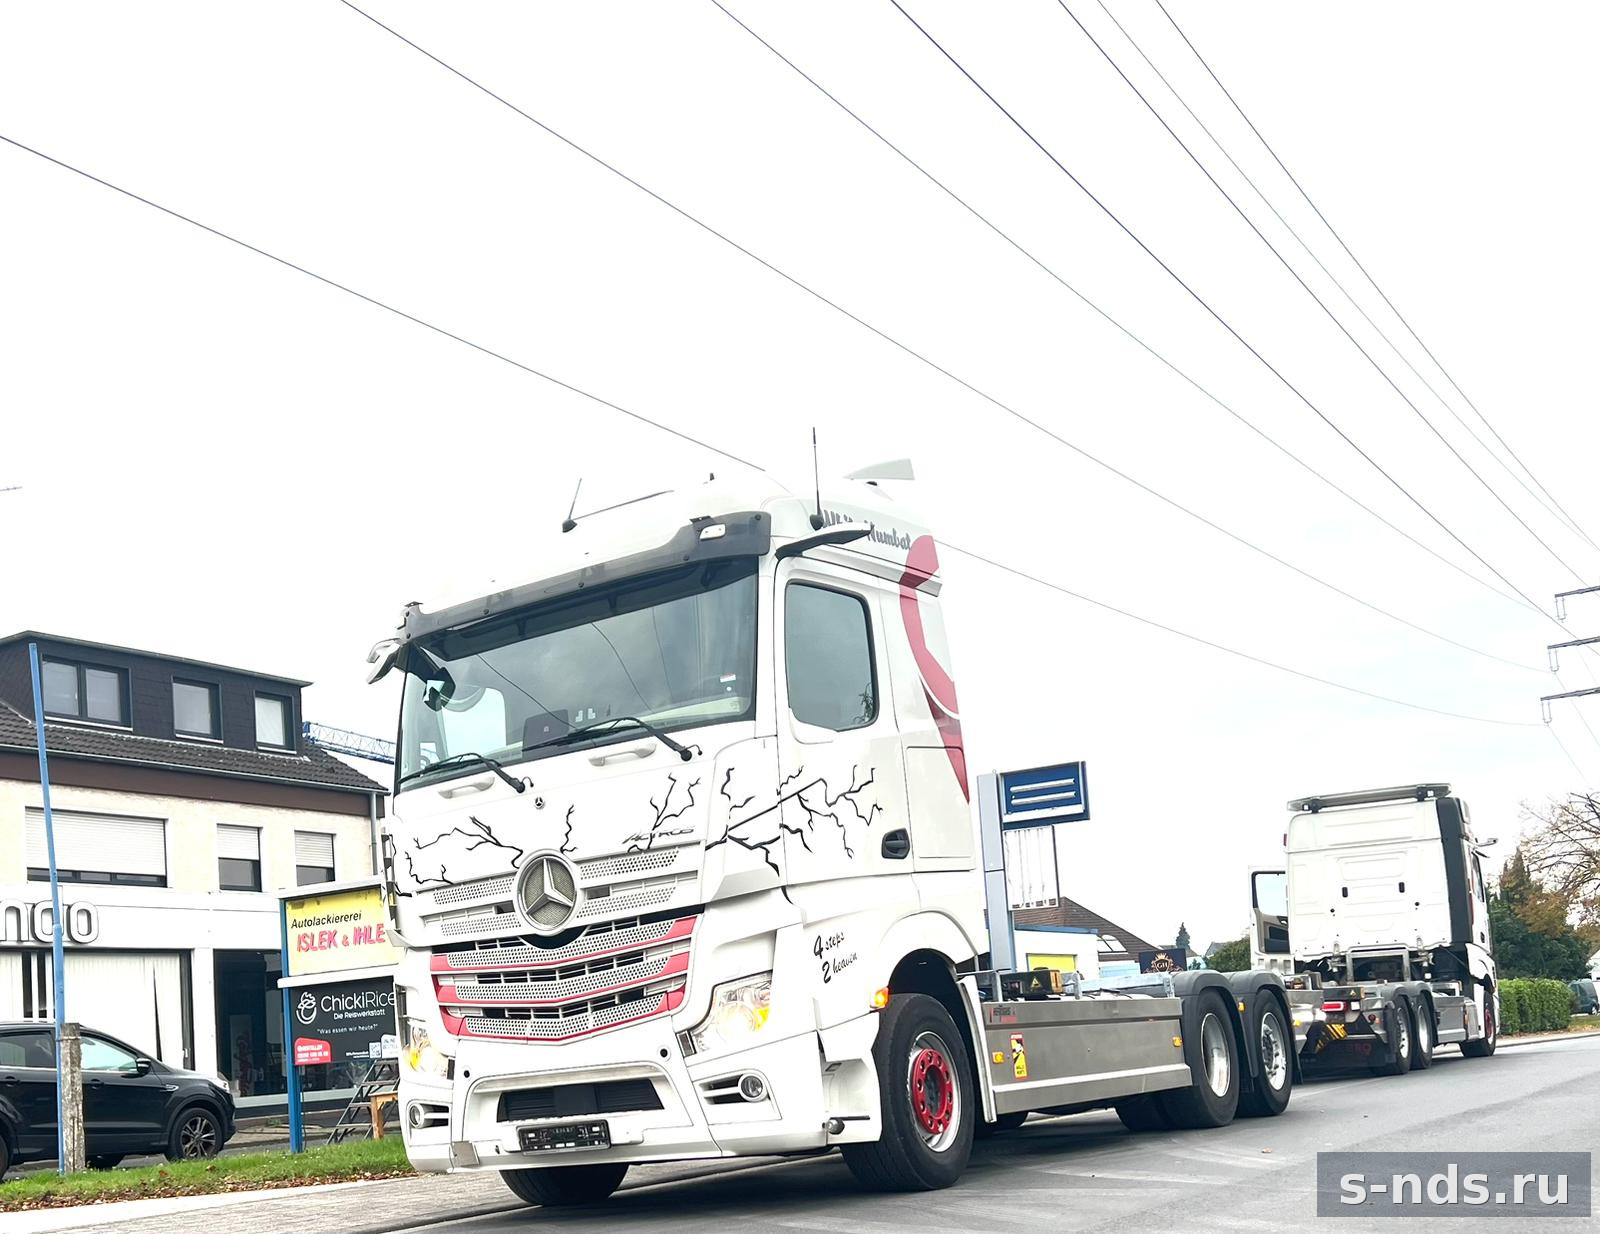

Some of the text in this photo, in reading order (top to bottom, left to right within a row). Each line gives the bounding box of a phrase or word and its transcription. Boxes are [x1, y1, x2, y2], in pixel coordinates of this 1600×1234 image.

[297, 923, 386, 952] ISLEK & IHLE
[813, 934, 824, 960] 4
[822, 961, 832, 984] 2
[320, 991, 396, 1012] ChickiRice
[334, 1012, 343, 1020] Die
